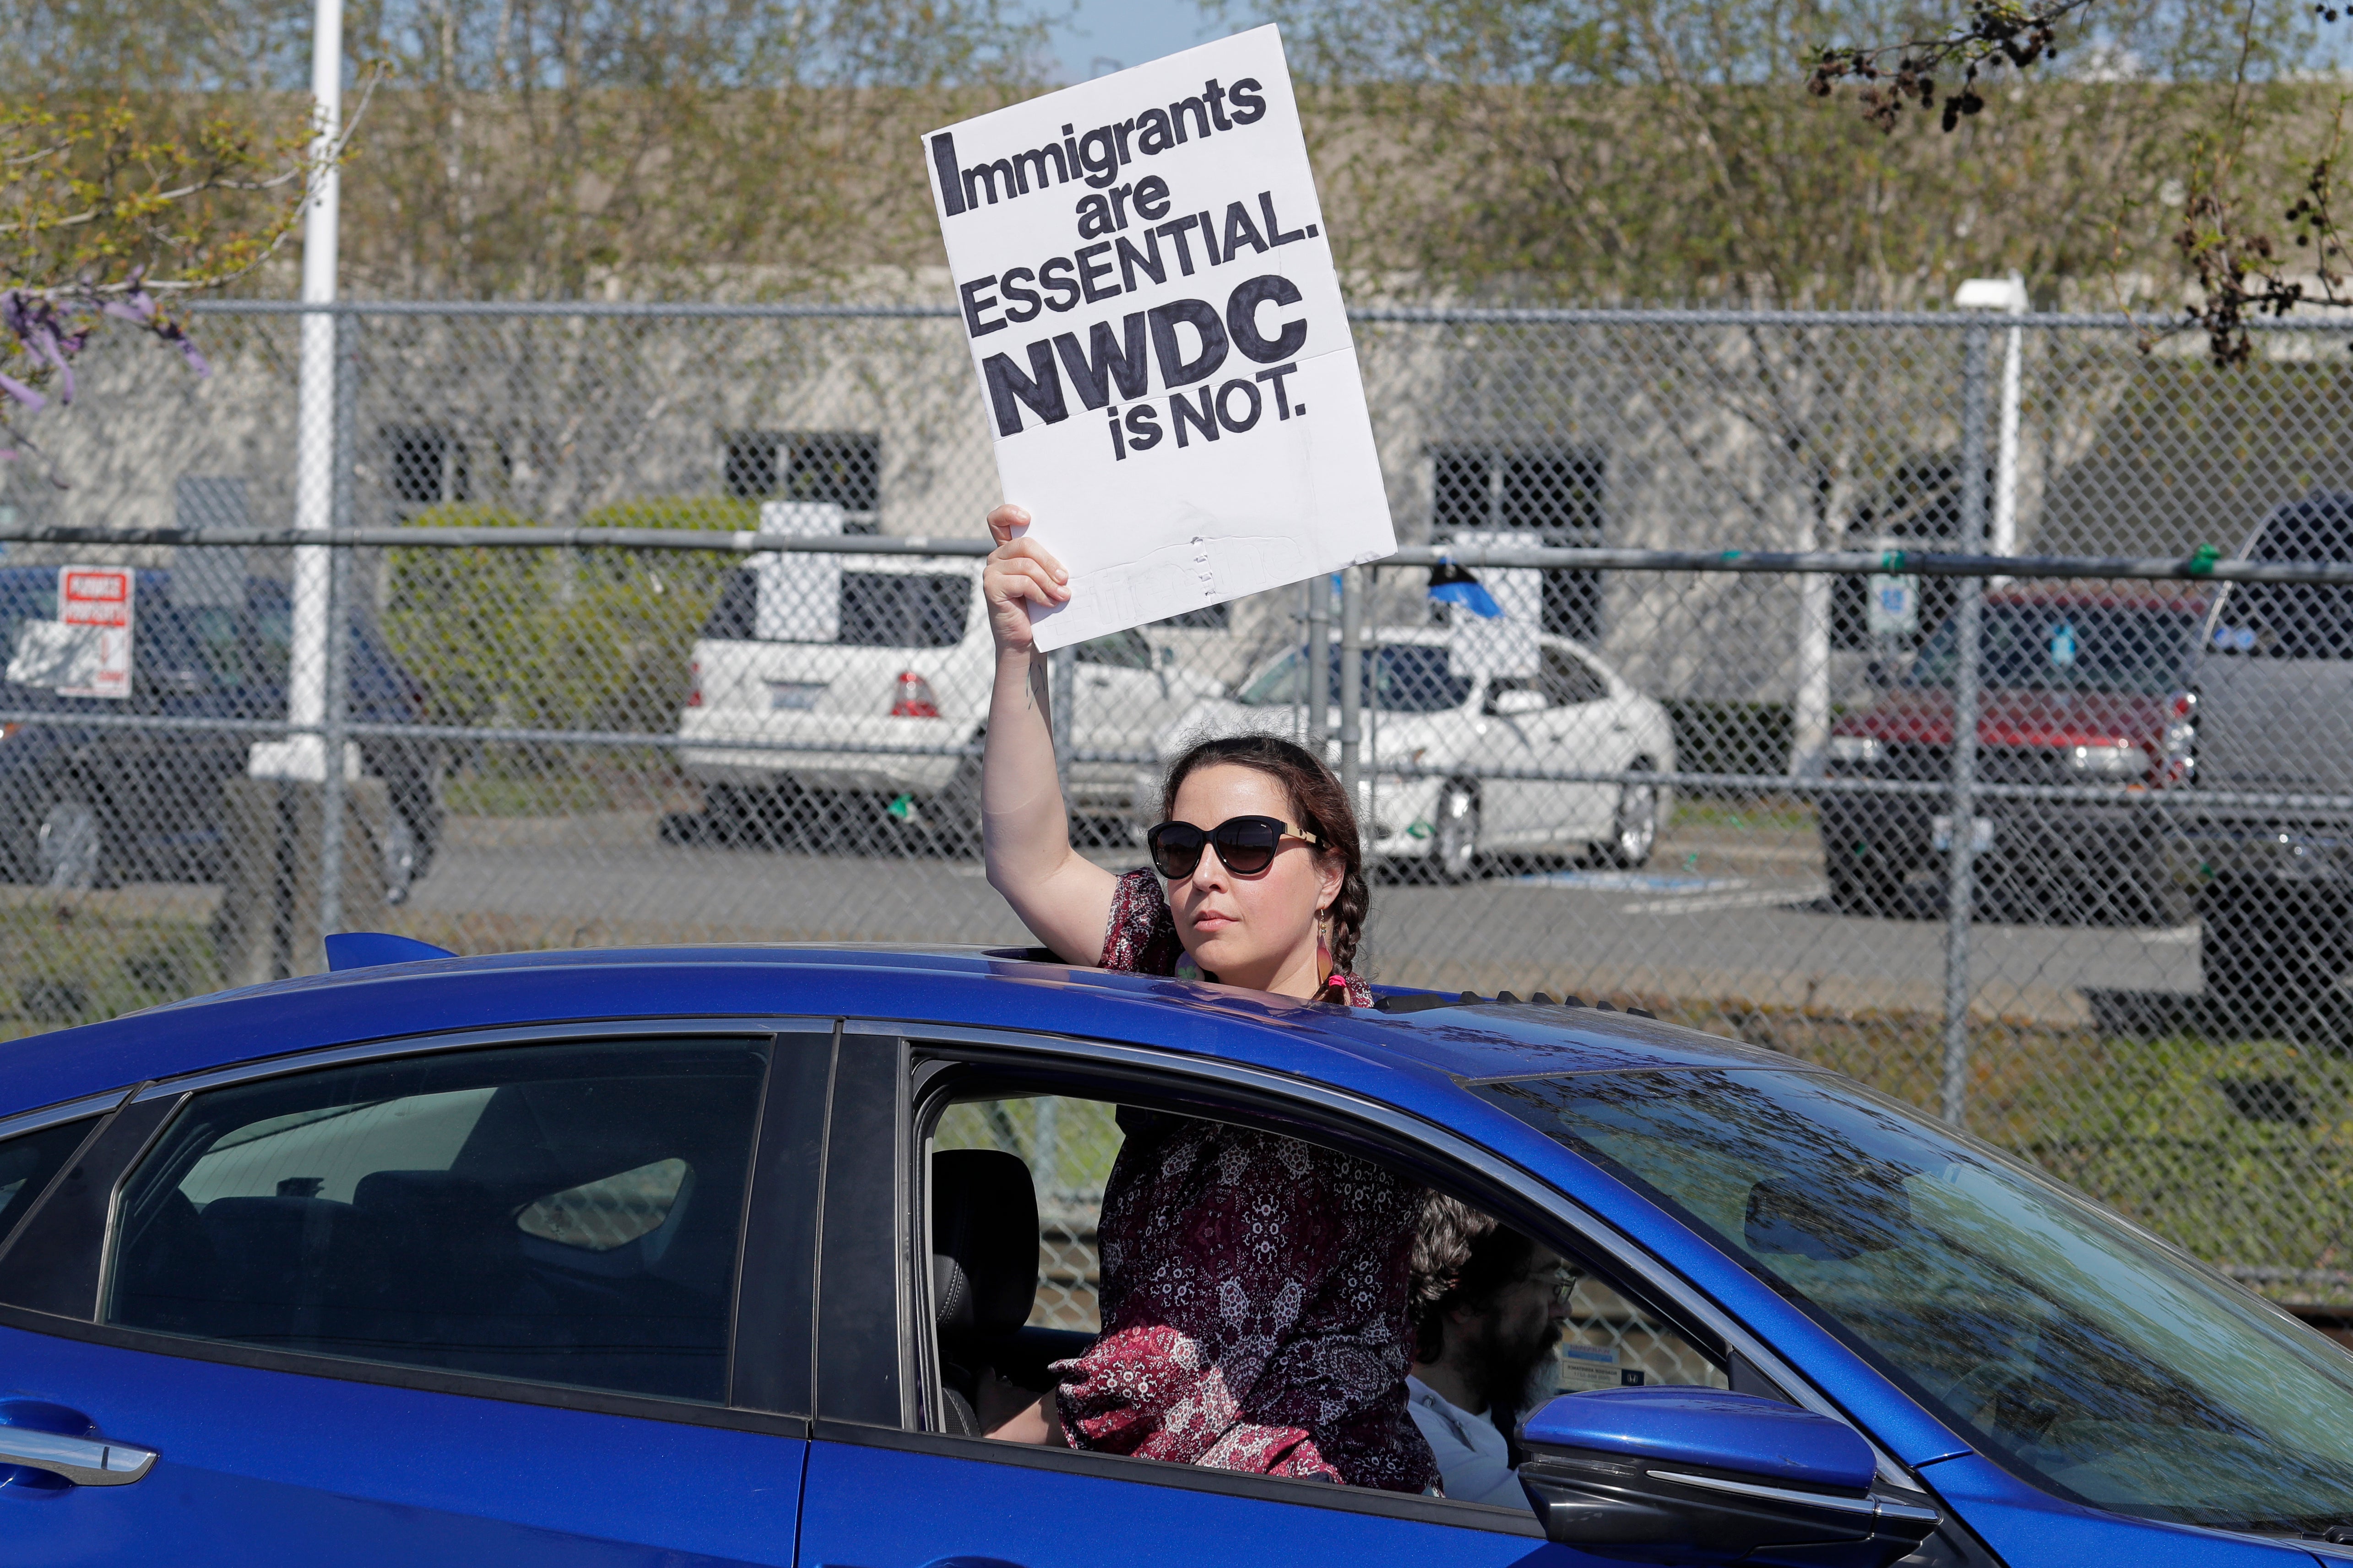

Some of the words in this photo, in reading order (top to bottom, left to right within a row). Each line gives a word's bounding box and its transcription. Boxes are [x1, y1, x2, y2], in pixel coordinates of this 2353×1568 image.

[931, 78, 1266, 217] Immigrants
[1076, 175, 1171, 240] are
[962, 190, 1319, 338] ESSENTIAL.
[982, 275, 1307, 437] NWDC
[1107, 404, 1163, 461] is
[1169, 362, 1306, 449] NOT.
